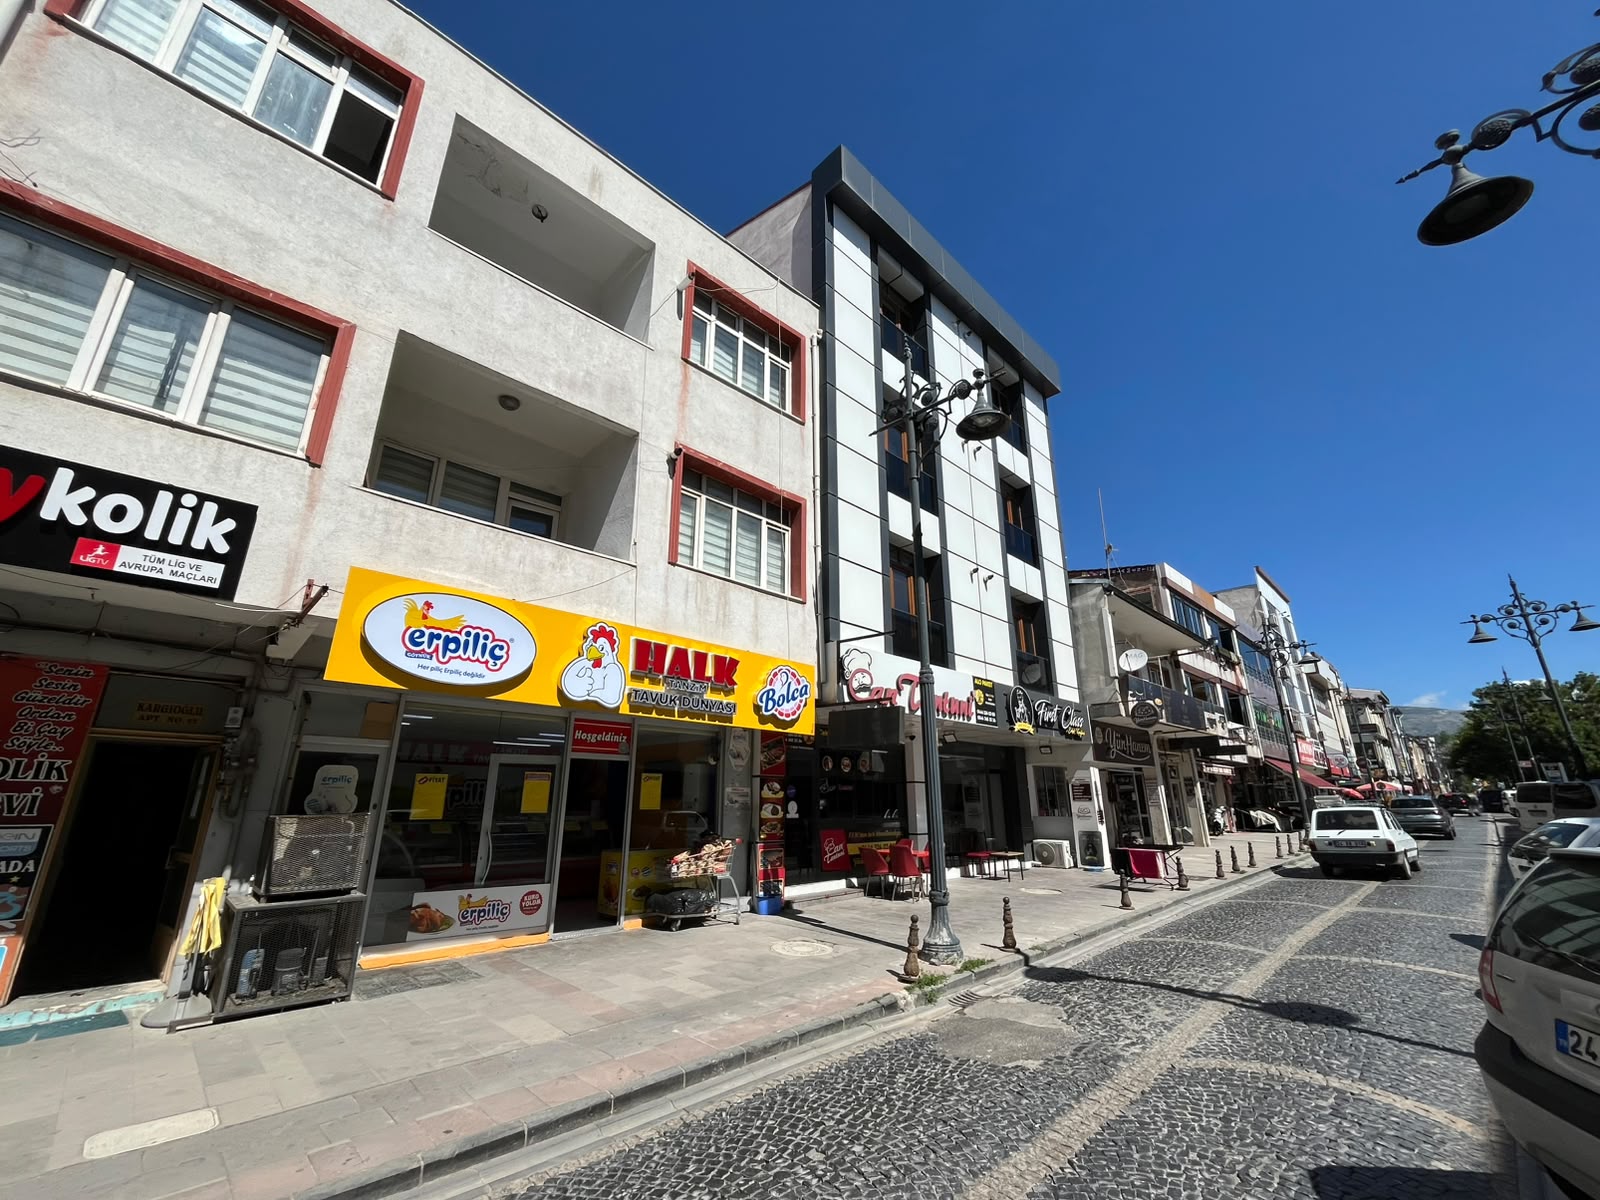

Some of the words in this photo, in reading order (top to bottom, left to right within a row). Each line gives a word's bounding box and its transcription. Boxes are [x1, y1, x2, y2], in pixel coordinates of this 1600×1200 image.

[119, 561, 164, 575] AVRUPA
[169, 569, 217, 584] MAÇLARI
[142, 553, 166, 565] TÜM
[168, 558, 186, 569] LİG
[188, 563, 202, 572] VE
[407, 628, 506, 668] erpiliç
[417, 663, 429, 671] Her
[430, 665, 443, 674] piliç
[444, 667, 462, 677] Erpiliç
[632, 637, 741, 688] HALK
[32, 677, 82, 692] Sesin
[12, 689, 93, 708] Güzeldir
[632, 688, 680, 708] TAVUK
[759, 680, 809, 713] Bolca
[895, 673, 976, 718] Tntuni
[16, 705, 77, 722] Ordan
[1034, 699, 1063, 727] First
[1061, 705, 1085, 730] Class
[10, 721, 36, 734] Bi
[35, 722, 74, 741] Çay
[574, 730, 628, 743] Hoşgeldiniz
[0, 786, 45, 817] Vİ
[459, 900, 510, 925] erpiliç
